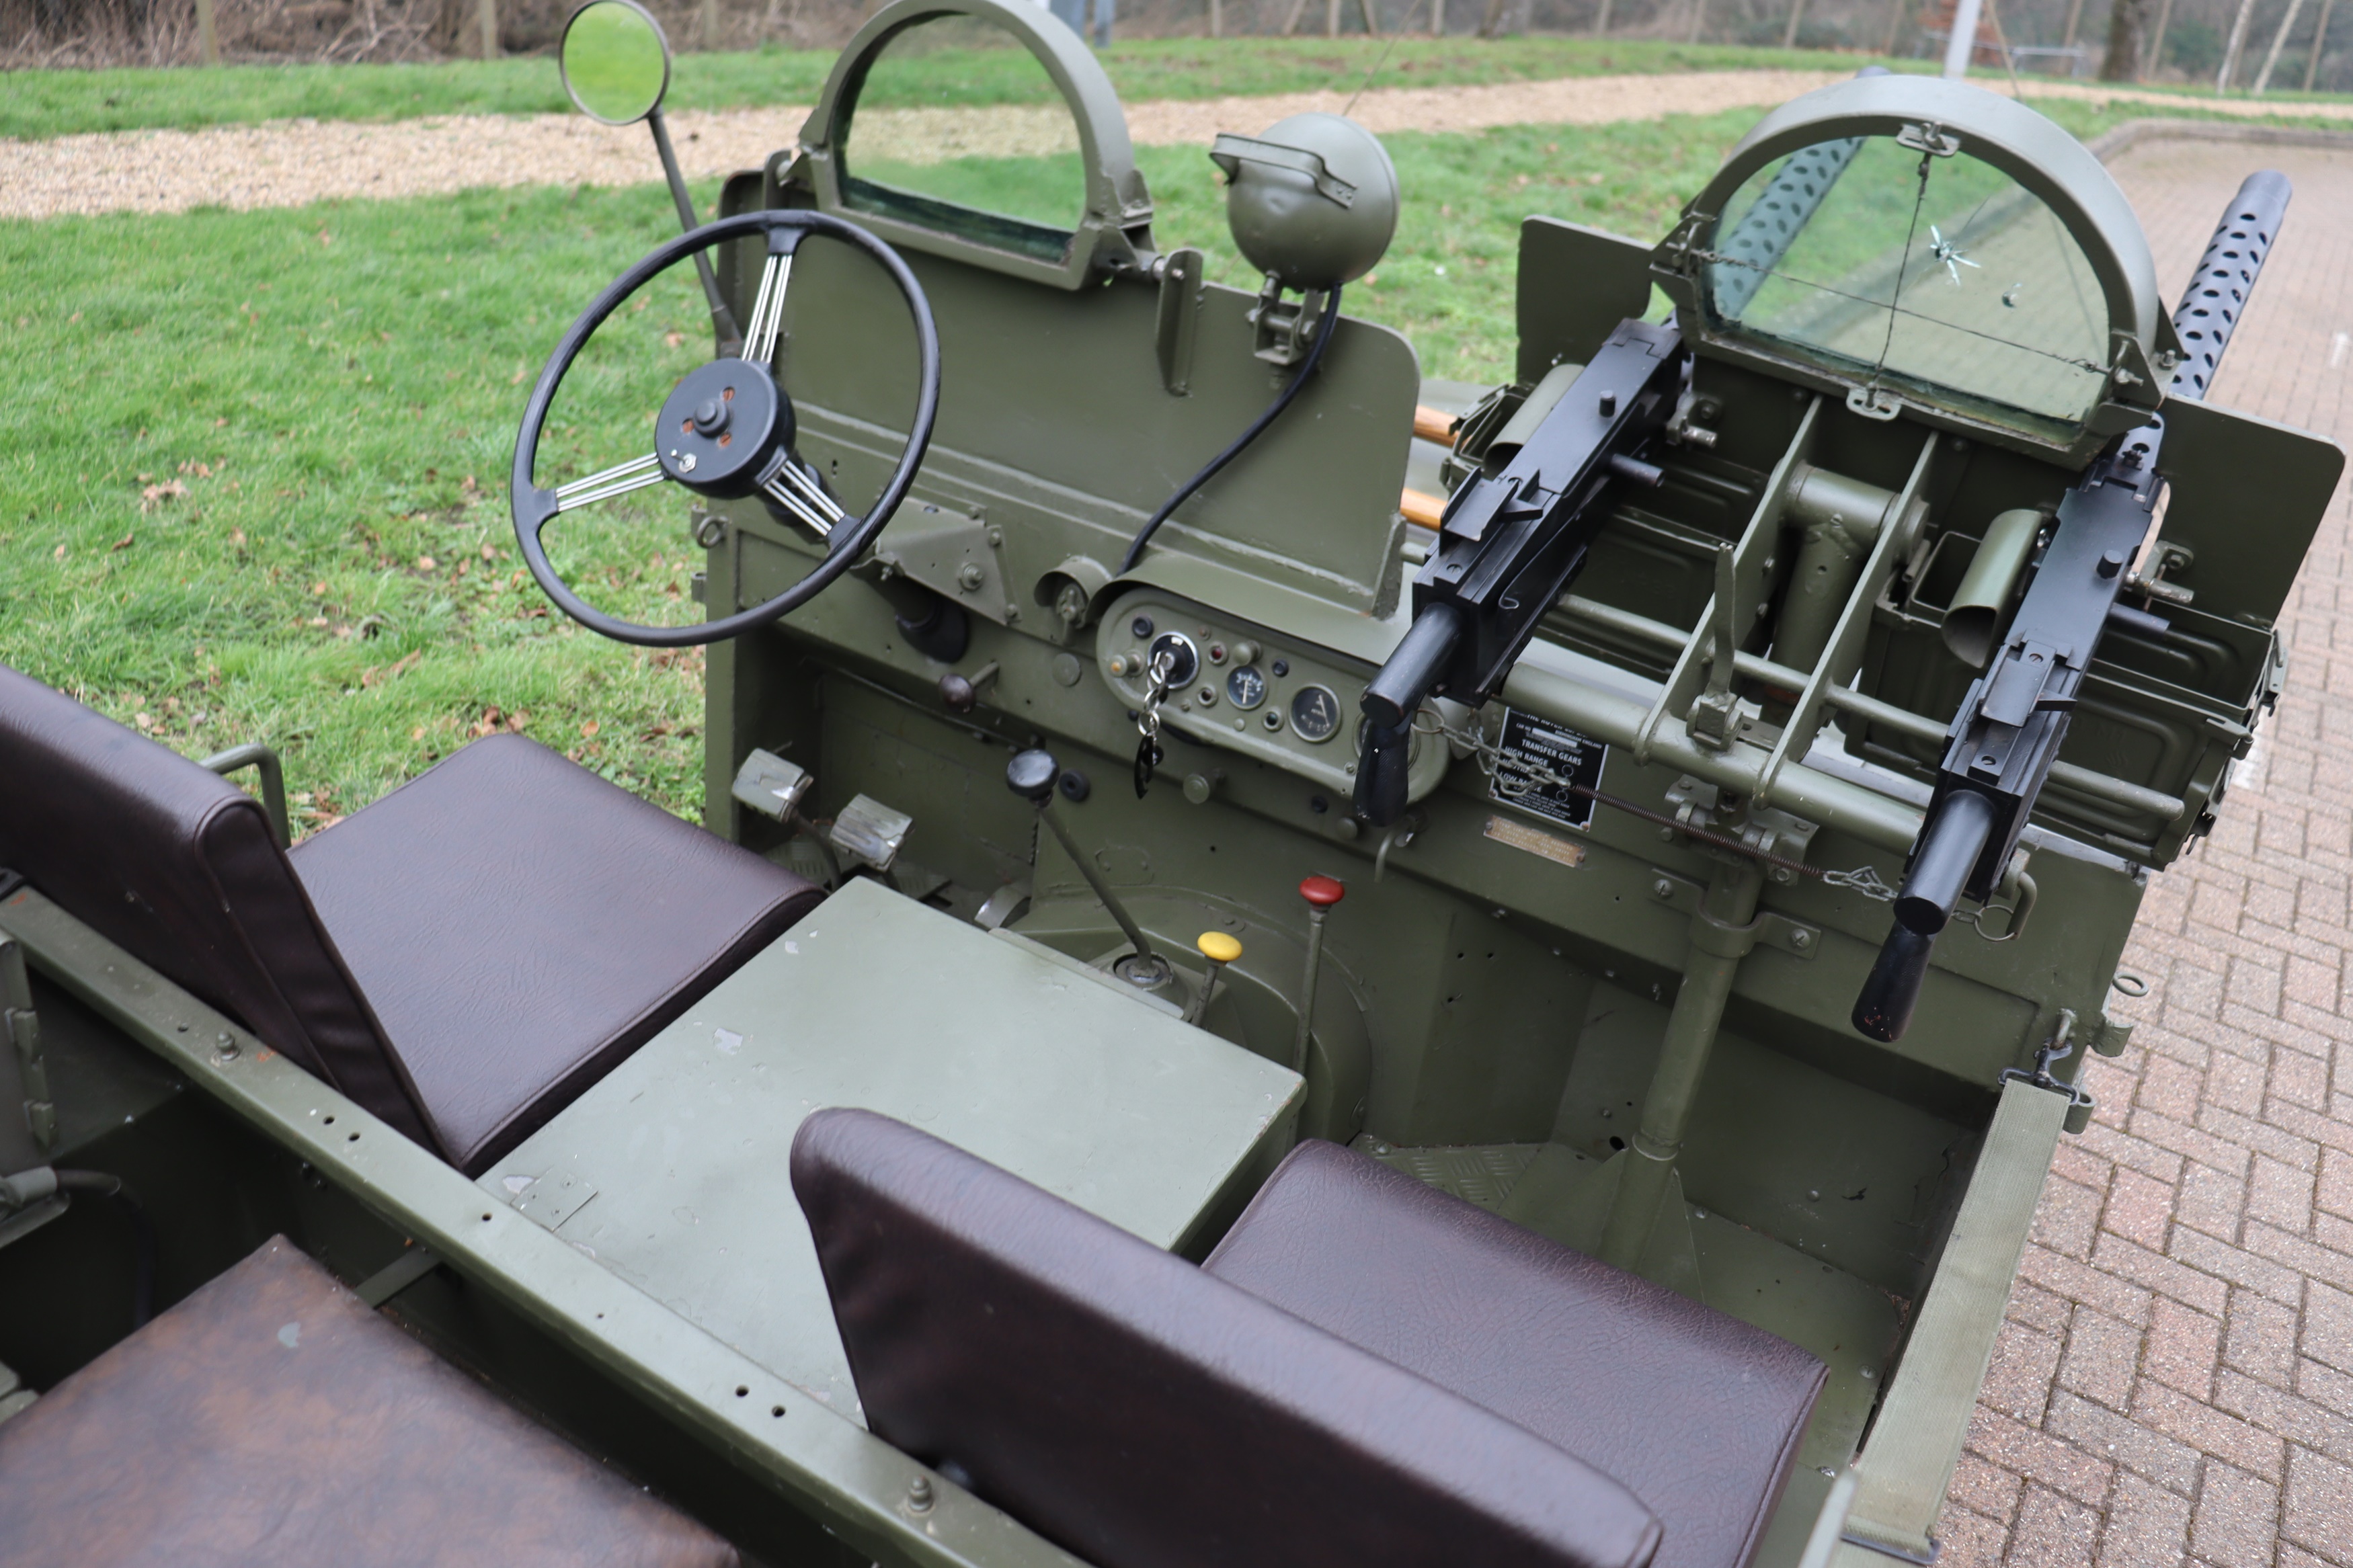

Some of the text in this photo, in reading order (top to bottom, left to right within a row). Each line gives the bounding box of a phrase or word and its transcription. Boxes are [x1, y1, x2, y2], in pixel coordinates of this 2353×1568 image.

[1521, 739, 1557, 757] TRANSFER
[1558, 751, 1583, 766] GEARS
[1582, 739, 1603, 749] ENGLAND
[1505, 746, 1549, 767] HIGH RANGE
